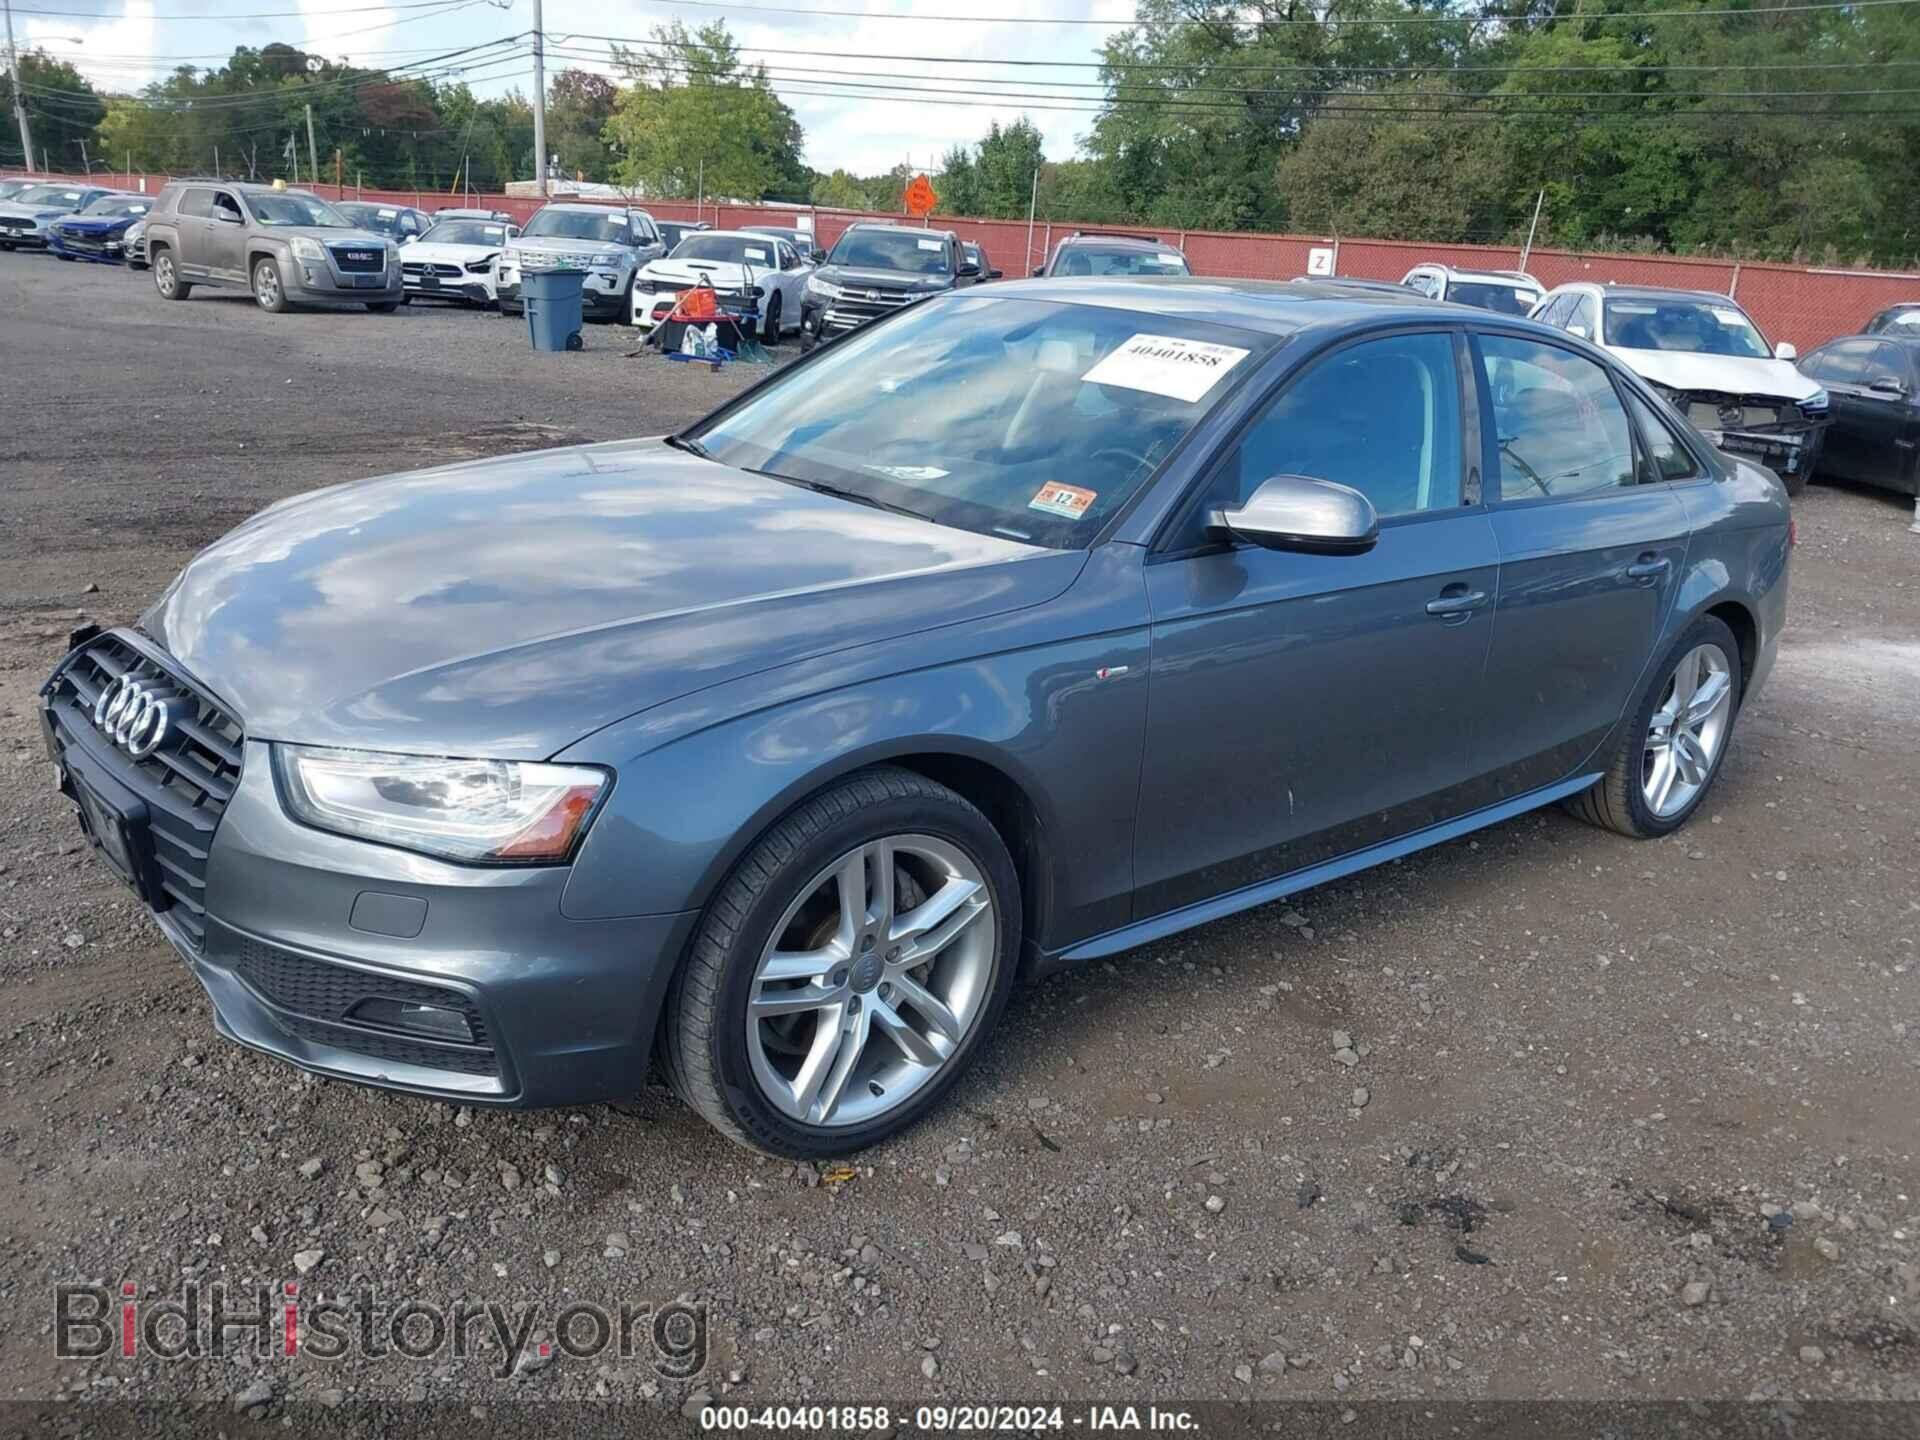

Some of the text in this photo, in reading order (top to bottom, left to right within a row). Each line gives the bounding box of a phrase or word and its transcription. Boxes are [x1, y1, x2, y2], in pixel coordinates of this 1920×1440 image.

[1315, 255, 1325, 269] Z
[1128, 344, 1222, 367] 40401858
[1056, 493, 1073, 505] 12
